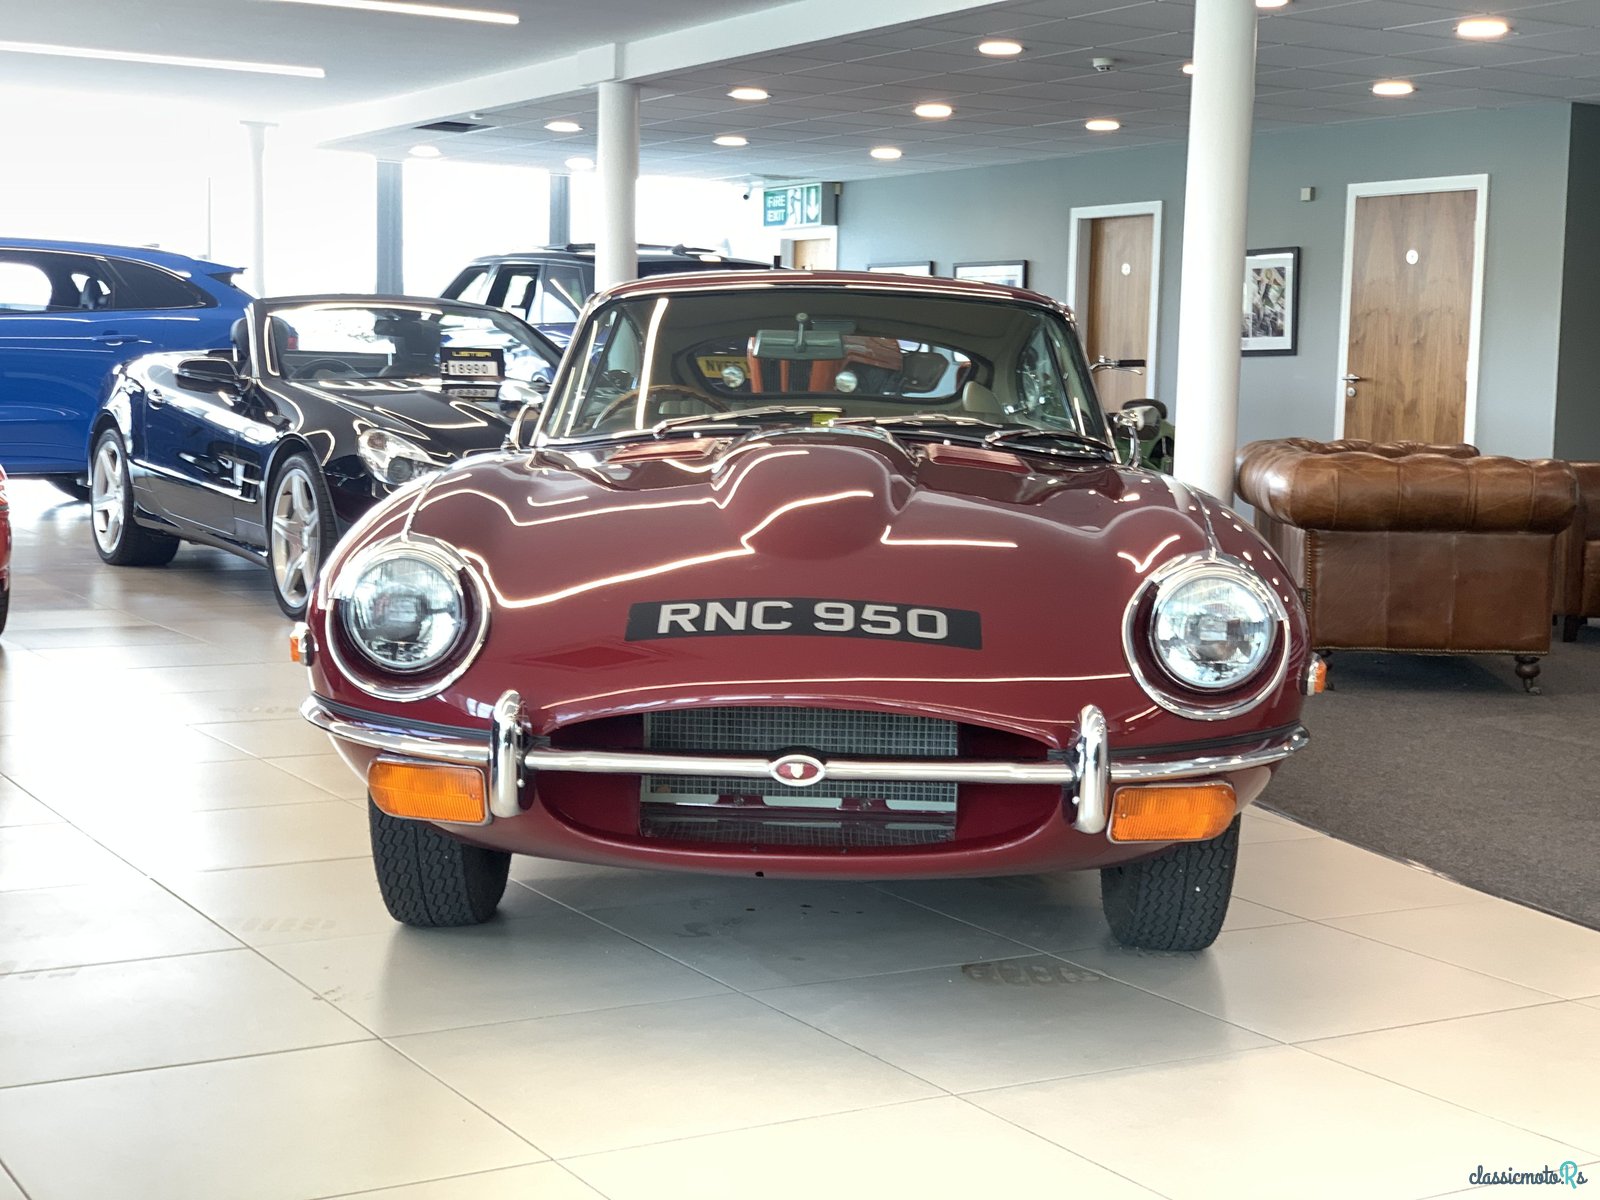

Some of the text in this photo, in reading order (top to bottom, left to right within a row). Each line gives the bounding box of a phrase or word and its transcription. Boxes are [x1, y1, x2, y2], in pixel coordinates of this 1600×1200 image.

[767, 195, 786, 208] FIRE
[767, 209, 786, 222] EXIT
[658, 601, 948, 639] RNC 950
